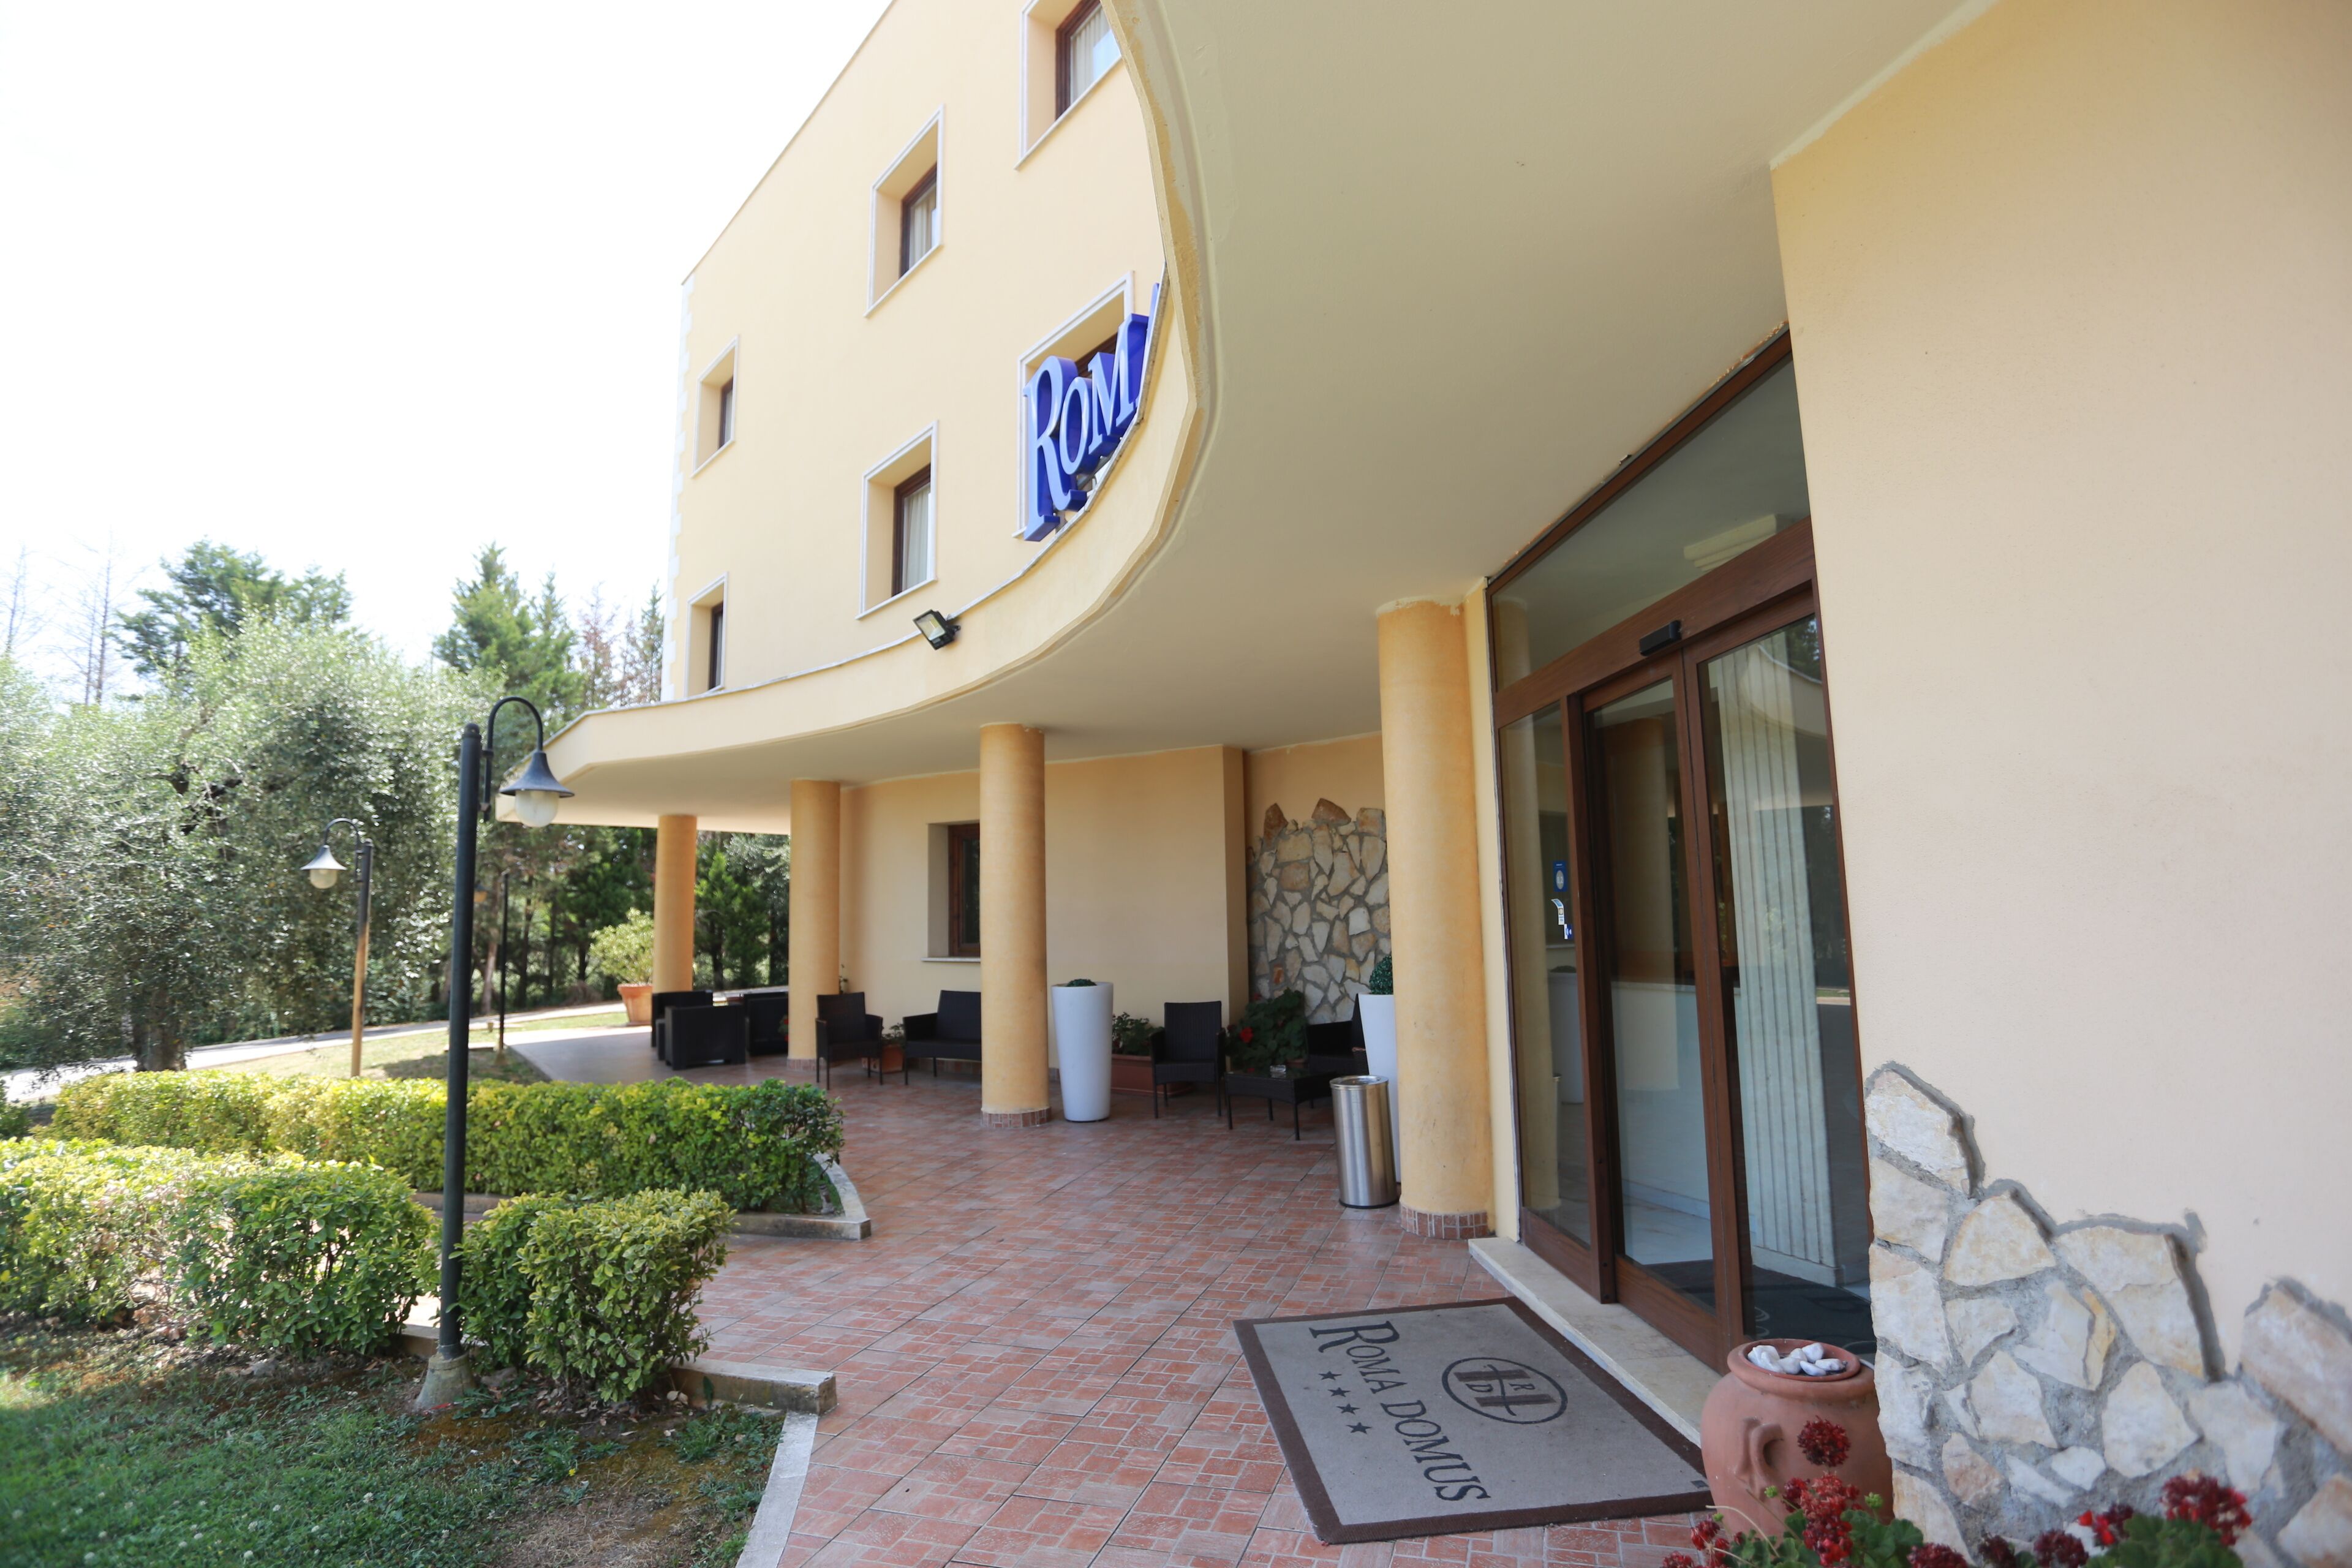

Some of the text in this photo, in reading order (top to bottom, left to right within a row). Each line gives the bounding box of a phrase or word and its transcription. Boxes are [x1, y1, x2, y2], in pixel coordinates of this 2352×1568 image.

[1023, 283, 1159, 541] ROM
[1308, 1320, 1491, 1501] ROMA DOMUS
